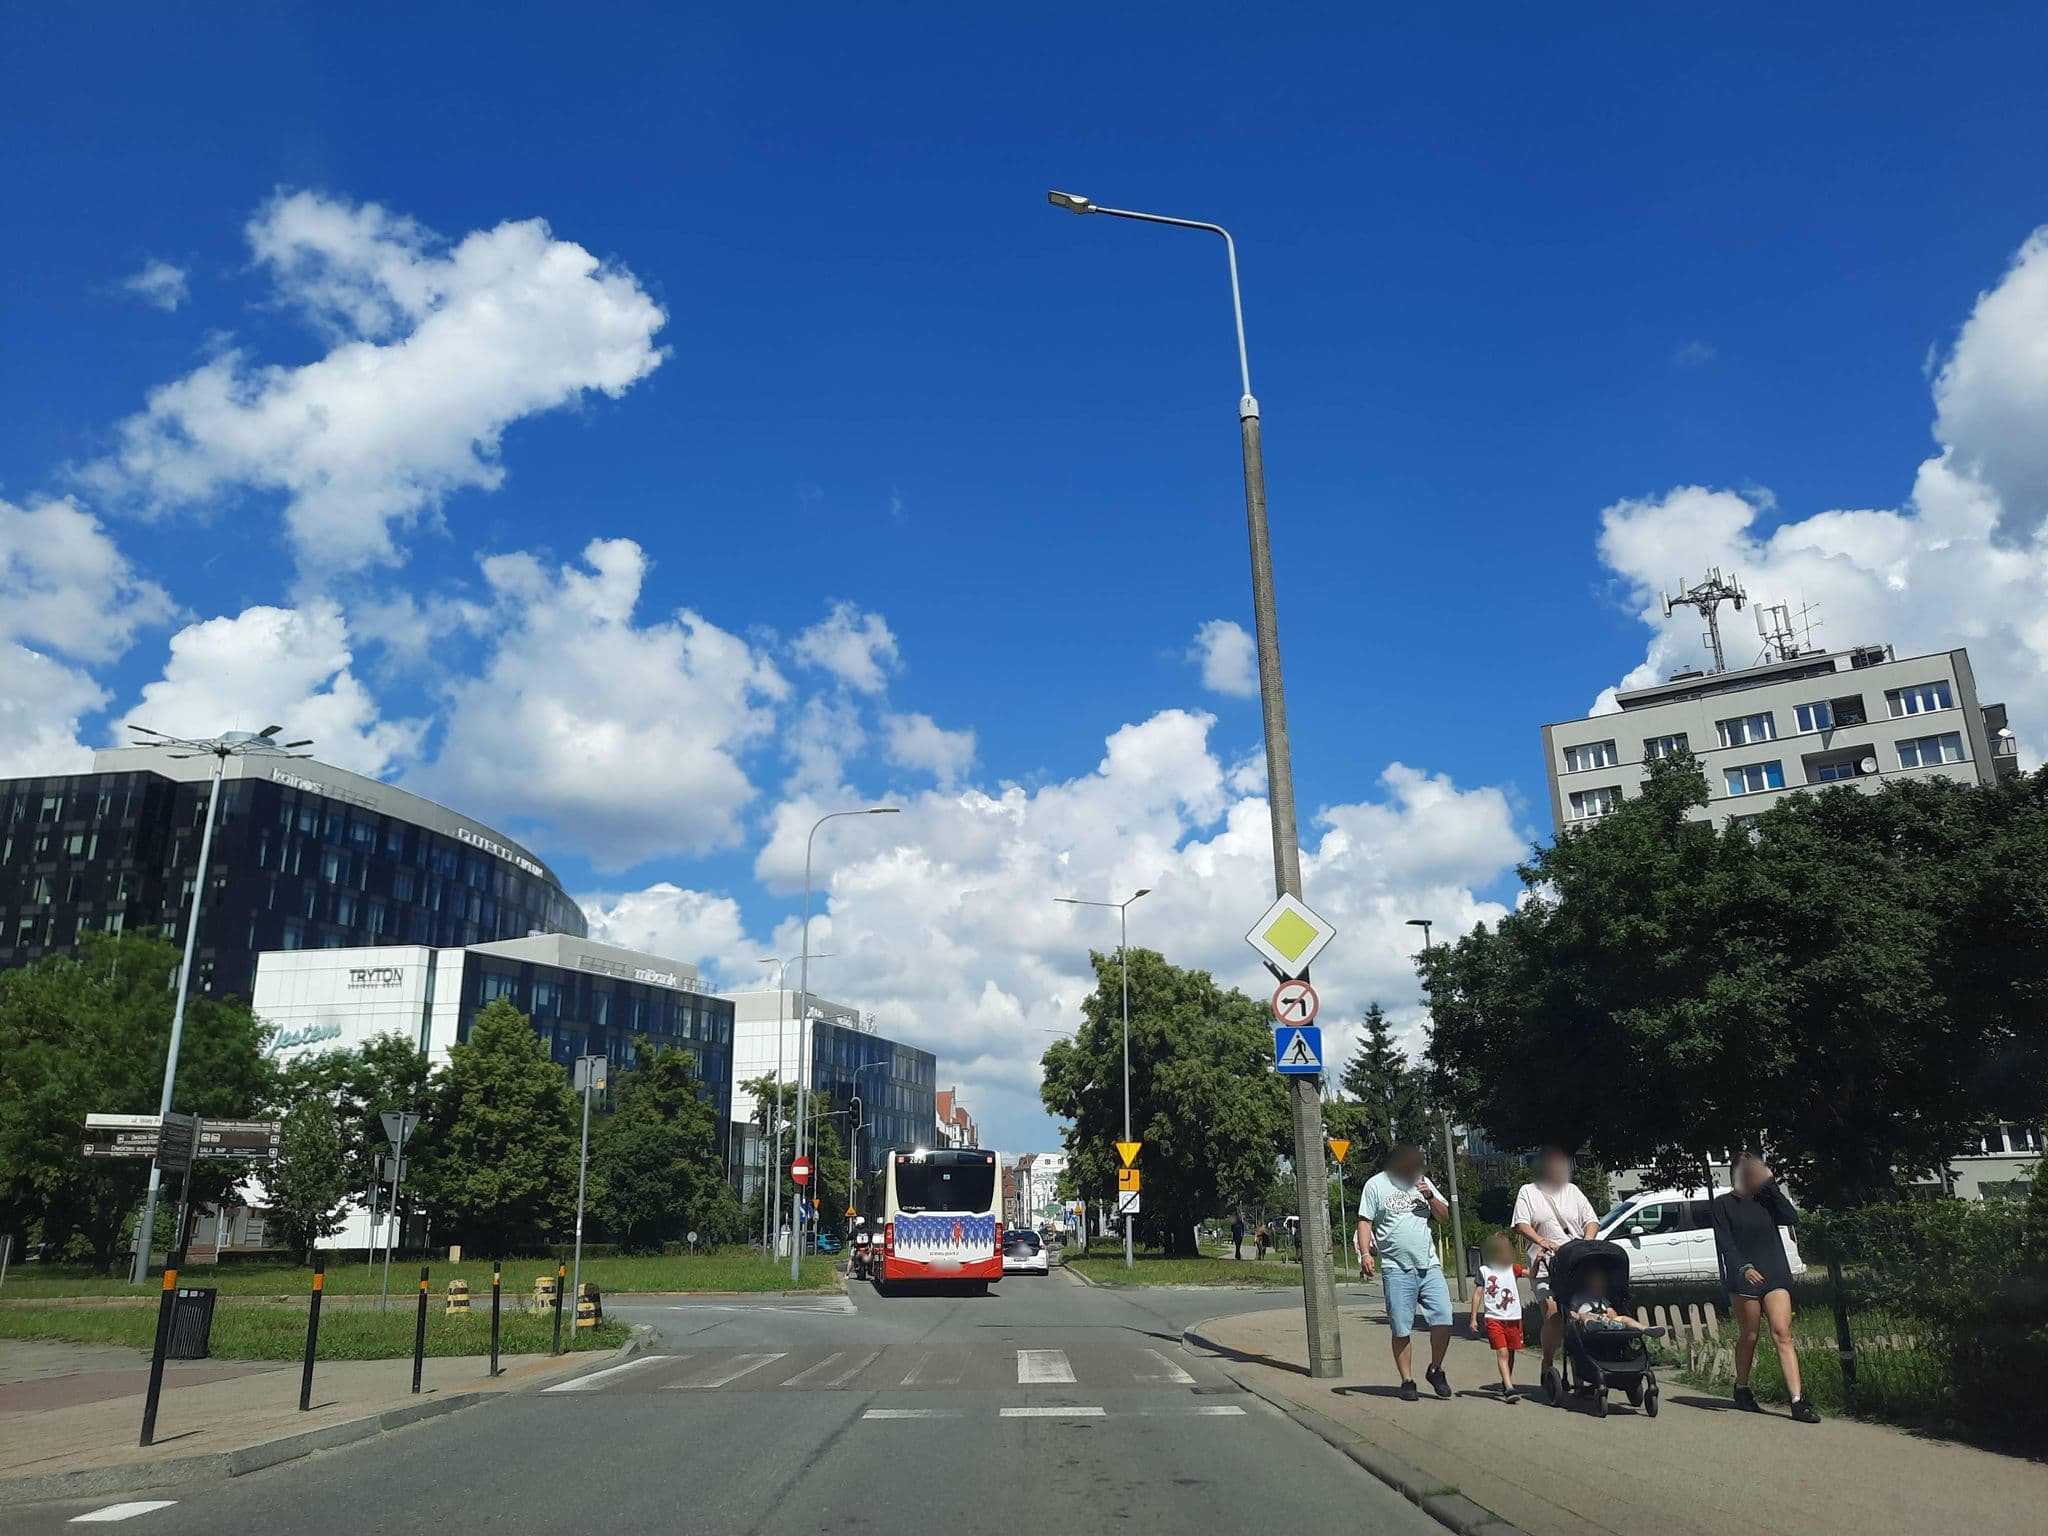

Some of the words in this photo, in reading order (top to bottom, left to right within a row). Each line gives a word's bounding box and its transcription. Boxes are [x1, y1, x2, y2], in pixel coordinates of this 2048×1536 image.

[272, 767, 323, 795] kainos
[350, 968, 403, 982] TRYTON
[635, 967, 677, 986] mBank
[263, 1023, 342, 1059] Jestem
